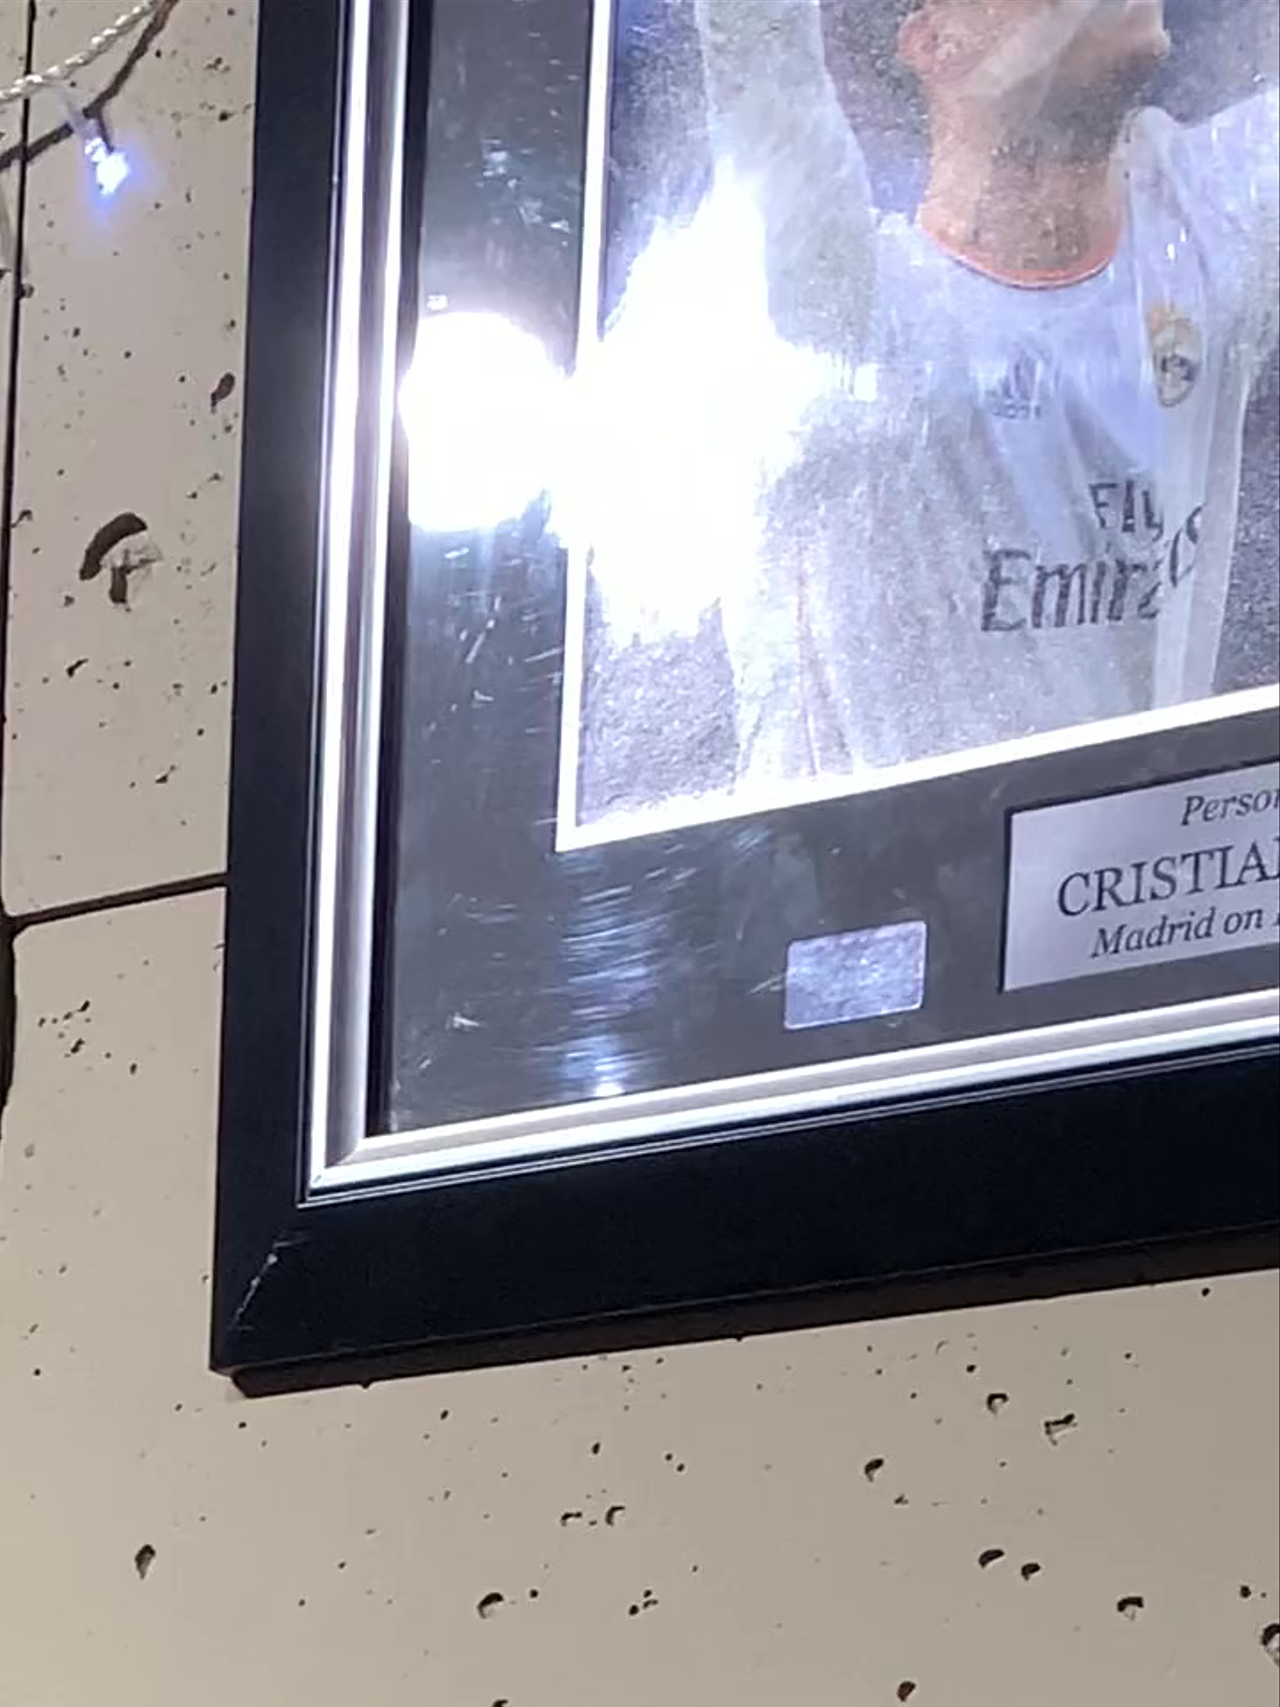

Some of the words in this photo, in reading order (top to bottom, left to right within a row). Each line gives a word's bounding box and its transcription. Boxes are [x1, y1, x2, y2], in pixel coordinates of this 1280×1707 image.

[1181, 788, 1280, 826] Perso
[1057, 836, 1280, 917] CRISTIA
[1091, 907, 1214, 958] Madrid
[1223, 906, 1264, 931] on
